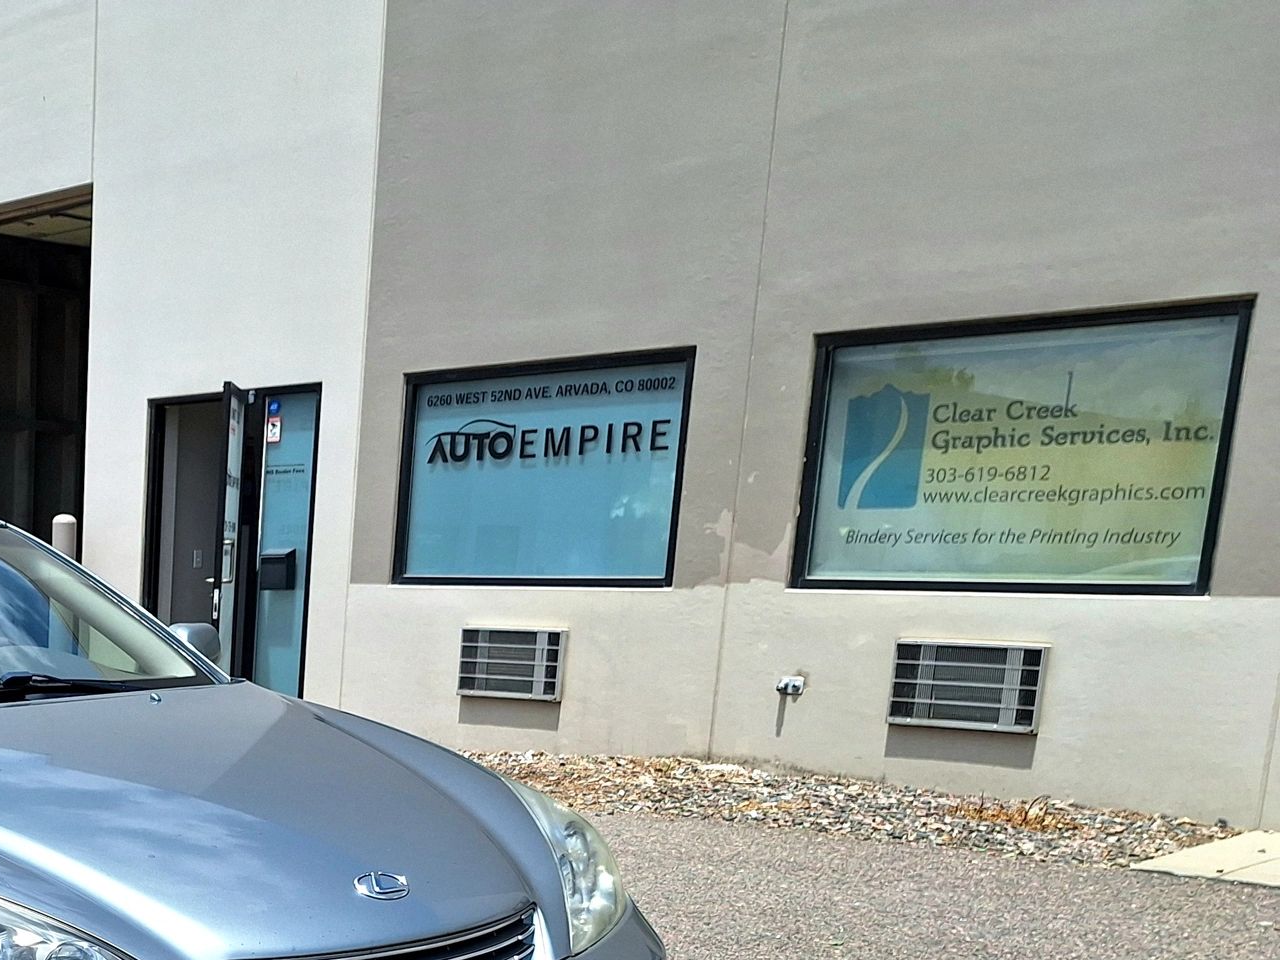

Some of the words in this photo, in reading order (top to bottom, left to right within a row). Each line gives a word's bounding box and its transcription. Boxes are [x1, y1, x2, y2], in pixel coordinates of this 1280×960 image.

[427, 394, 452, 407] 6260
[455, 391, 488, 405] WEST
[490, 388, 522, 402] 52ND
[525, 386, 552, 400] AVE.
[555, 382, 611, 397] ARVADA,
[615, 380, 634, 393] CO
[637, 376, 676, 391] 80002
[932, 402, 997, 424] Clear
[1006, 400, 1078, 420] Creek
[931, 427, 1031, 454] Graphic
[1040, 424, 1150, 447] Services,
[1162, 420, 1214, 441] Inc.
[925, 465, 1051, 484] 303-619-6812
[923, 482, 1205, 505] www.clearcreekgraphics.com
[845, 529, 902, 547] Bindery
[904, 528, 968, 544] Services
[971, 528, 996, 544] for
[999, 528, 1026, 544] the
[1029, 528, 1099, 548] Printing
[1102, 527, 1181, 548] Industry
